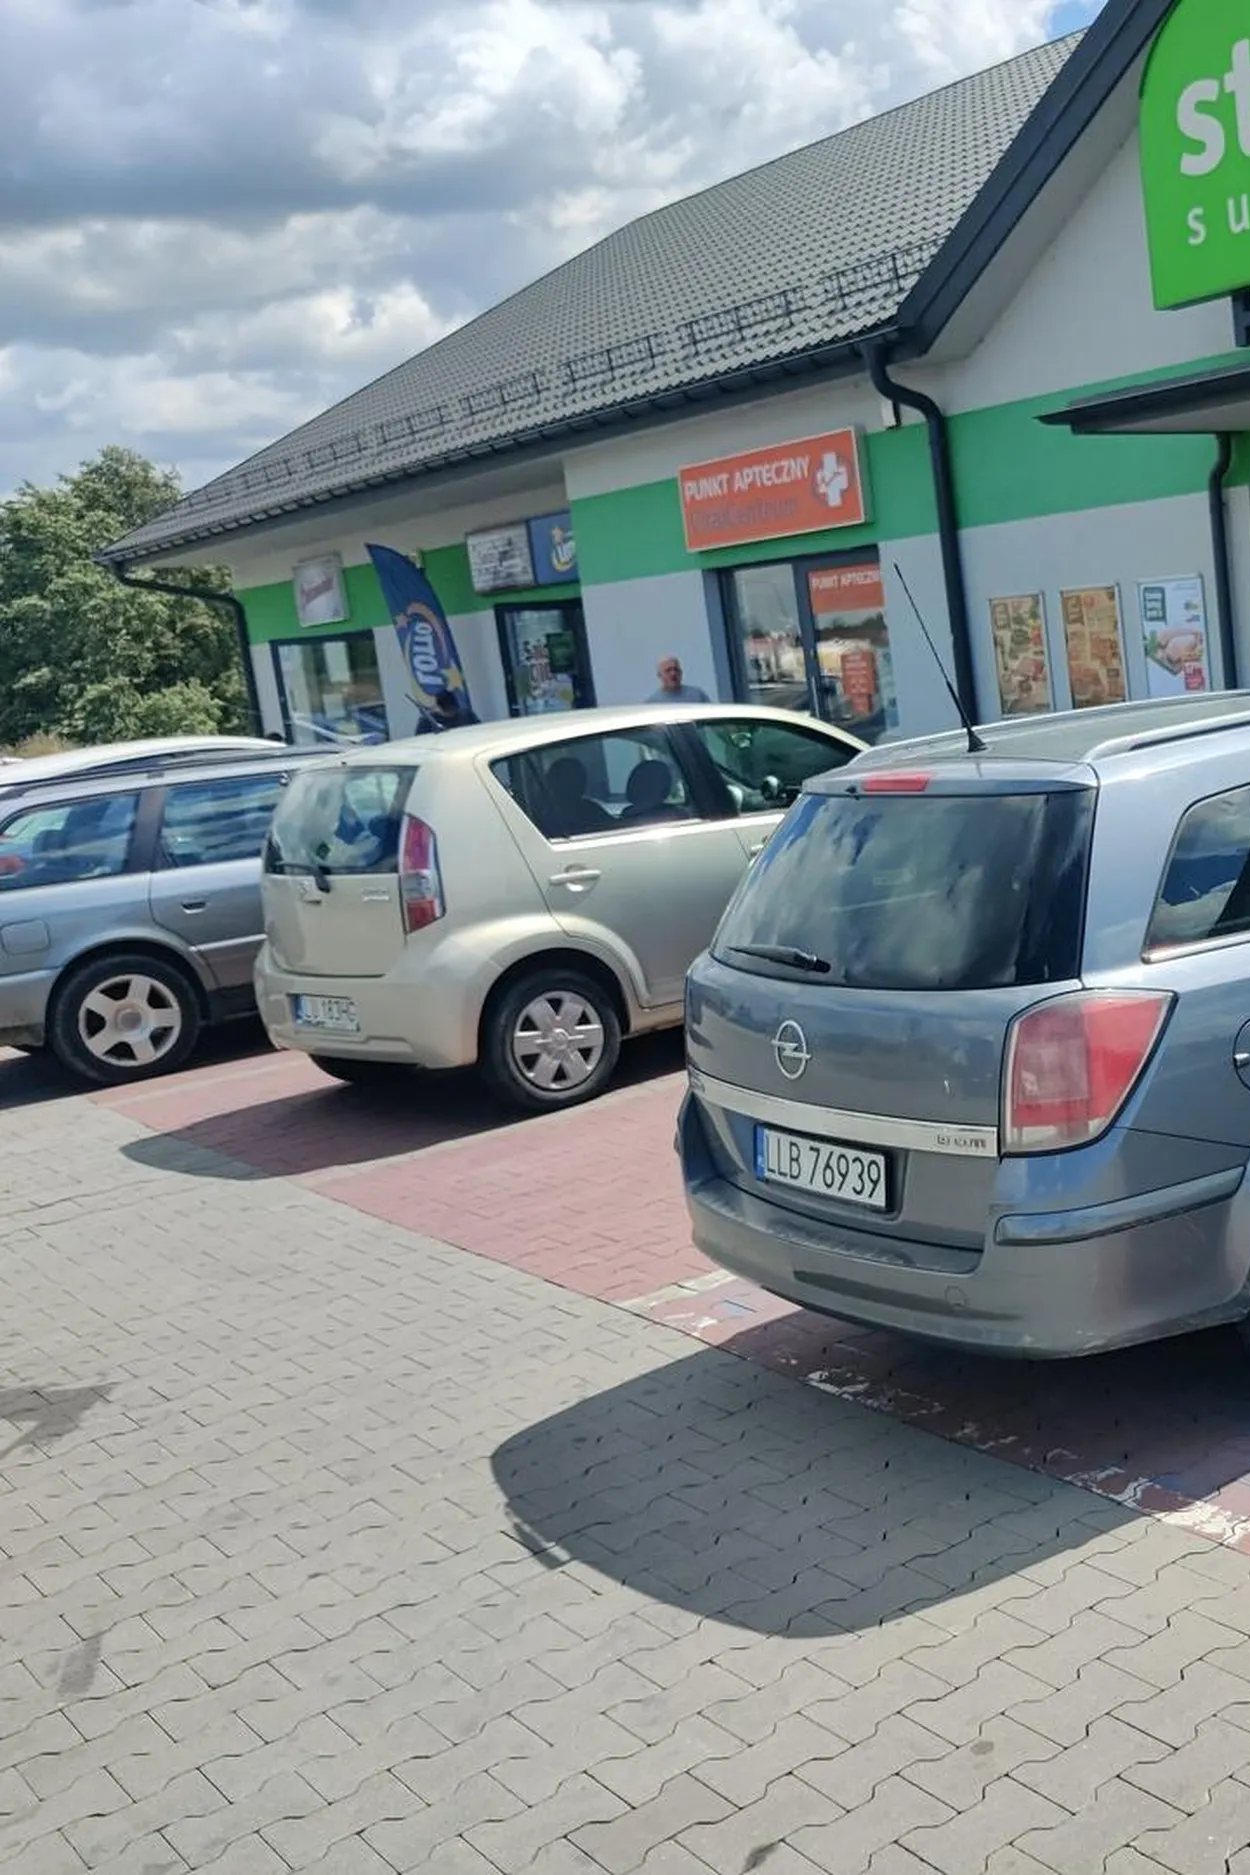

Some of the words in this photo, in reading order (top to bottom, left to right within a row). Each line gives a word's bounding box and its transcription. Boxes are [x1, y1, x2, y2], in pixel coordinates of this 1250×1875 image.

[684, 472, 731, 503] PUNKT
[733, 456, 811, 493] APTECZNY
[766, 1133, 801, 1180] LLB
[808, 1146, 881, 1199] 76939
